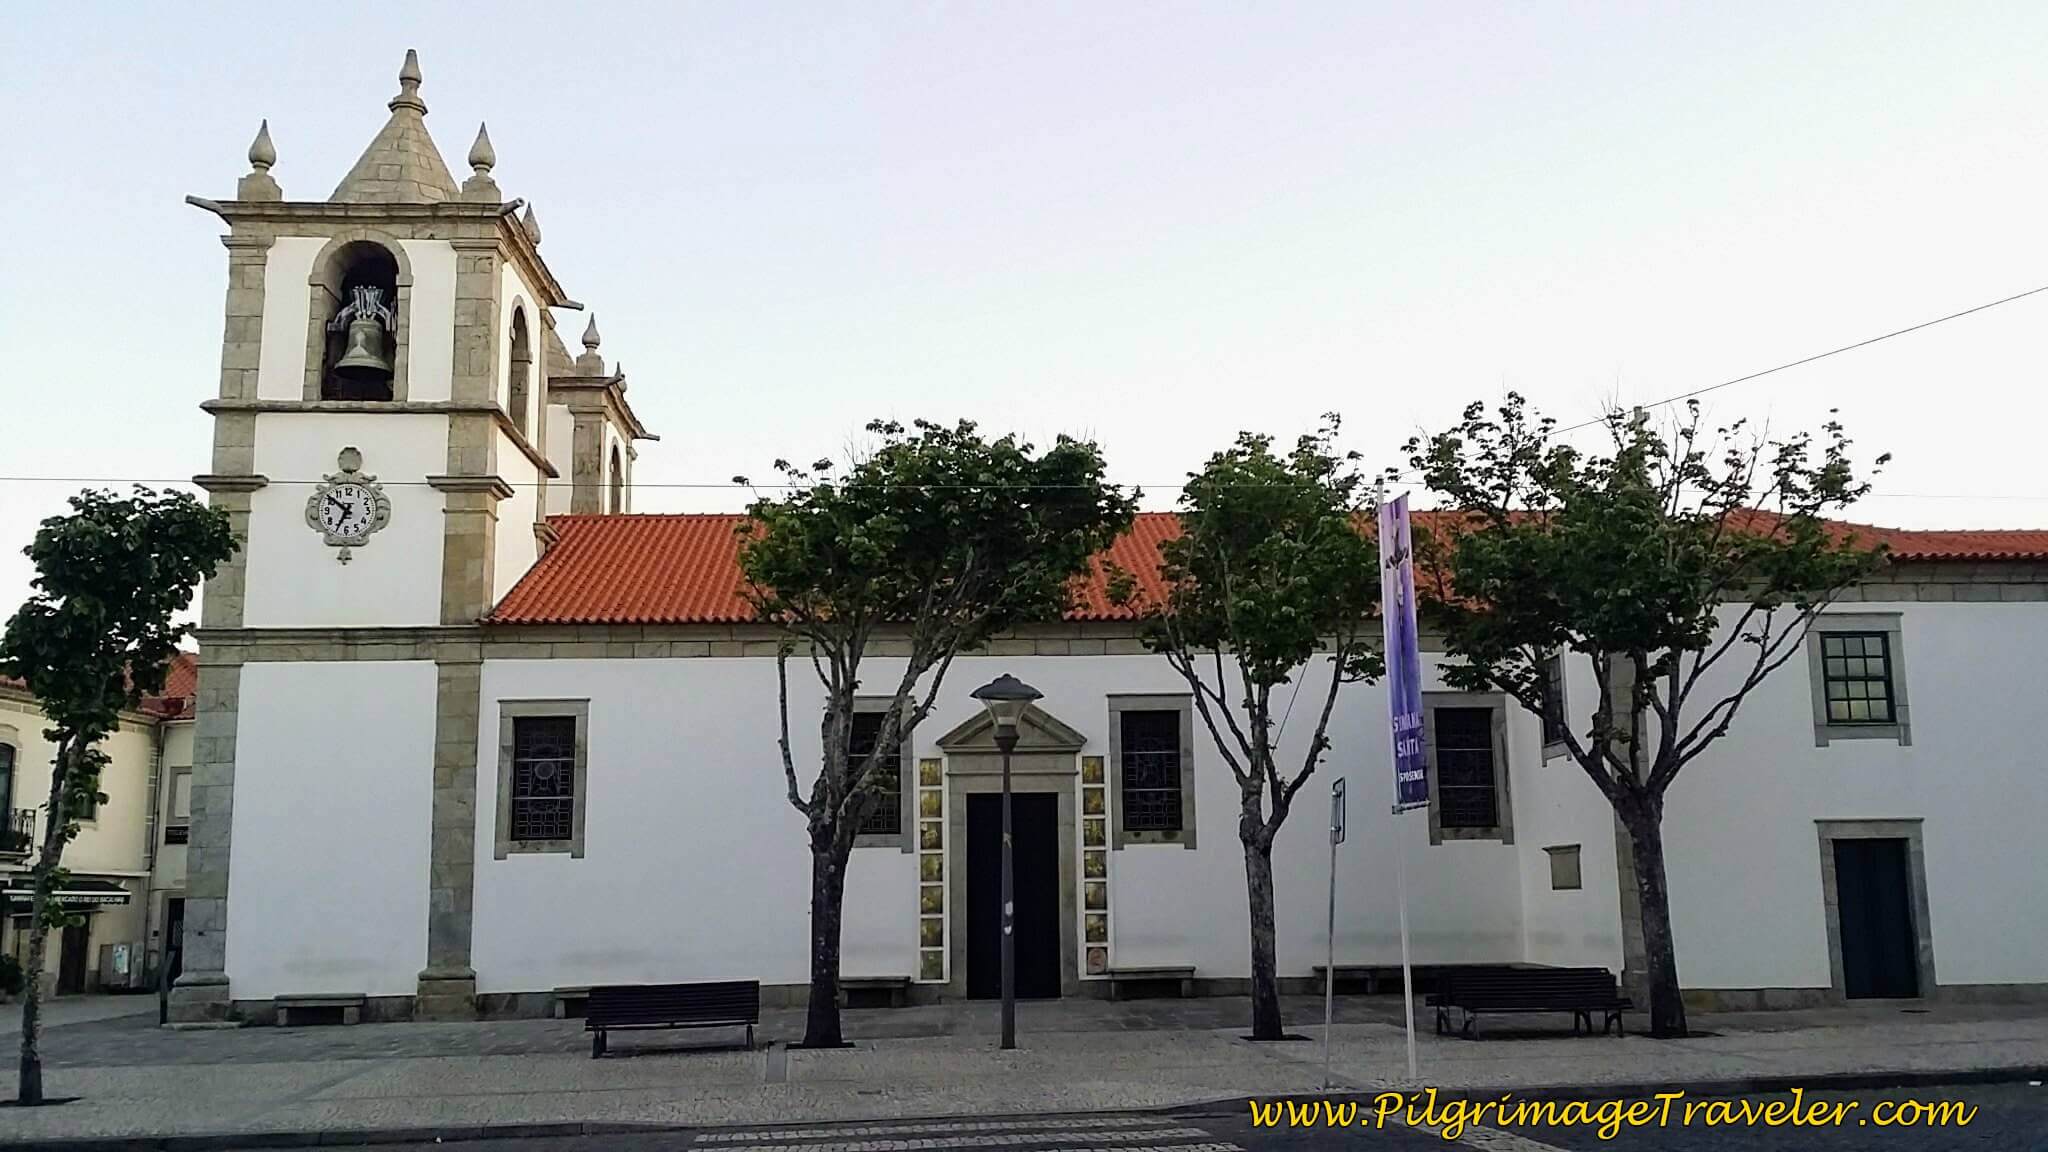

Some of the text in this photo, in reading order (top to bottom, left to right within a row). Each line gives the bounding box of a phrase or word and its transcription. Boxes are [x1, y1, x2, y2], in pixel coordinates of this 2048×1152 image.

[336, 490, 342, 499] 11
[345, 487, 353, 496] 12
[363, 497, 369, 506] 2
[324, 506, 330, 515] 9
[366, 506, 371, 515] 3
[327, 516, 333, 525] 8
[360, 516, 367, 525] 4
[343, 525, 350, 534] 6
[353, 523, 360, 533] 5
